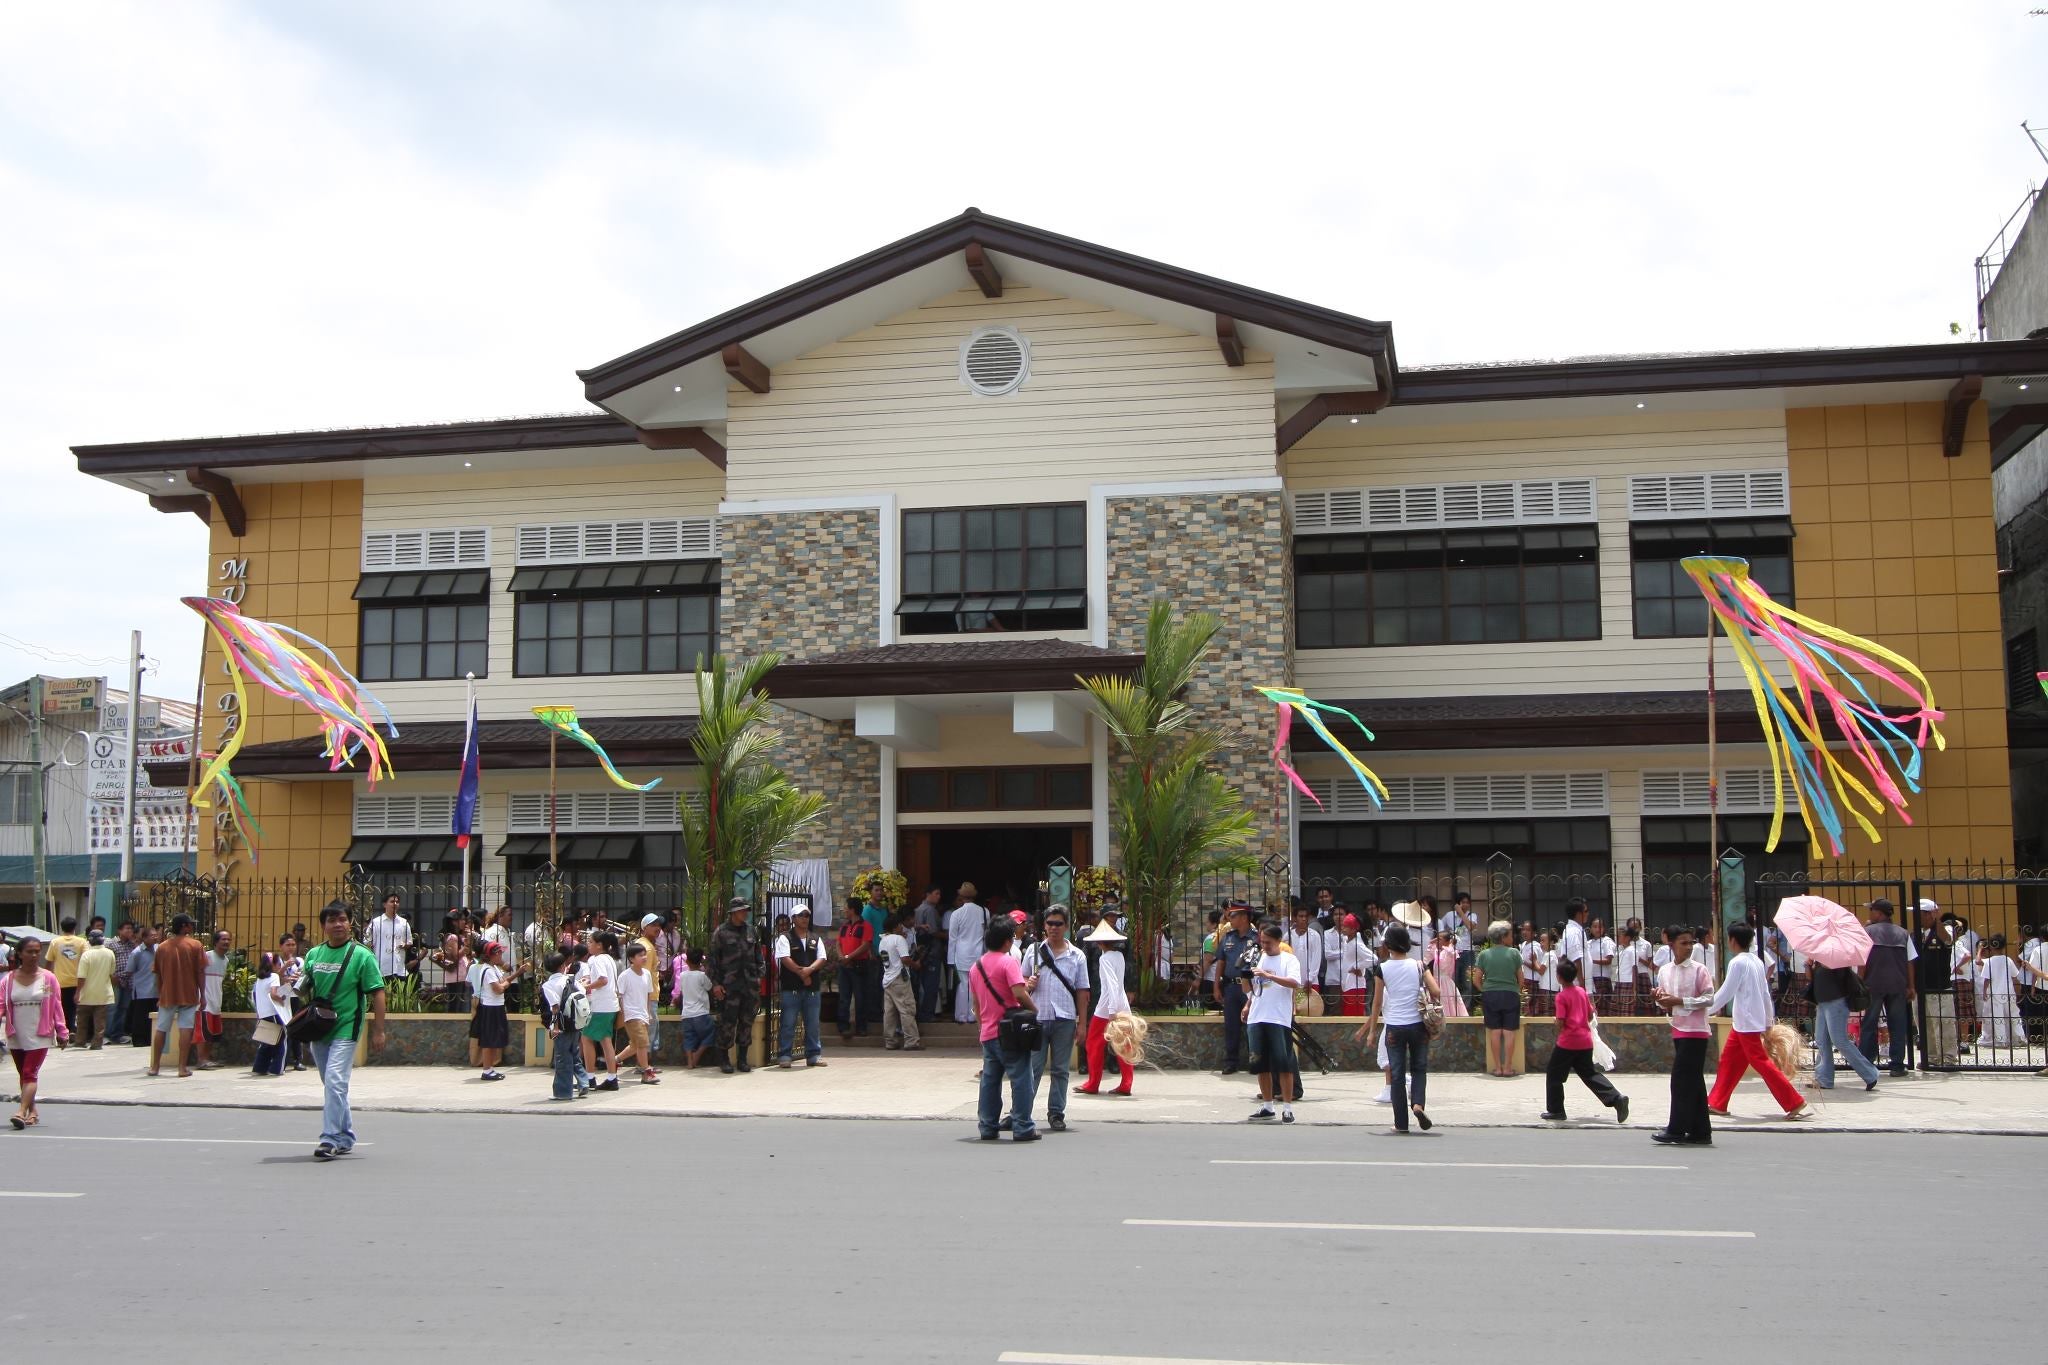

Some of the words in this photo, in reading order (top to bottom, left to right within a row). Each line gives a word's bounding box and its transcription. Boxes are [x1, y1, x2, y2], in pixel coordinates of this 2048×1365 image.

[136, 716, 156, 727] ENTER
[90, 759, 115, 769] CPA
[91, 790, 126, 798] CLASSE
